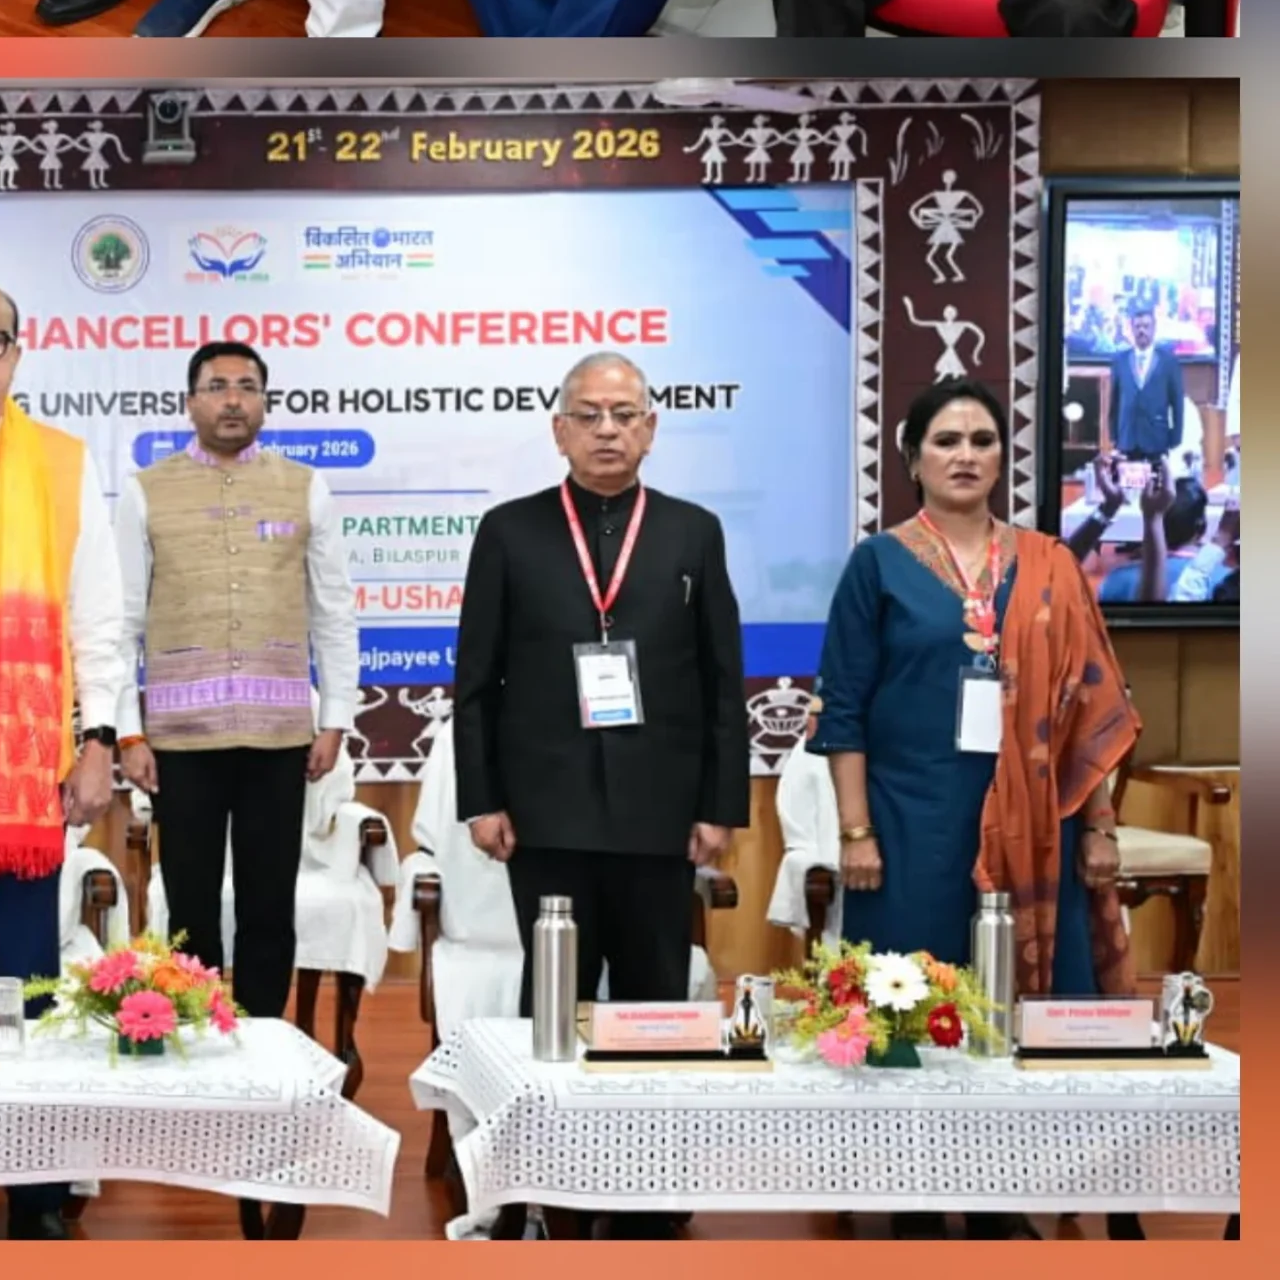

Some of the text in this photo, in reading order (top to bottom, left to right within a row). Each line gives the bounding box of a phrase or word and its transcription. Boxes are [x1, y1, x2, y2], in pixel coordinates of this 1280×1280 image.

[410, 131, 563, 167] February
[571, 128, 661, 159] 2026
[303, 226, 369, 248] विकसित
[335, 249, 403, 269] अभियान
[344, 308, 669, 347] CONFERENCE
[39, 391, 186, 418] UNIVERSI
[265, 388, 330, 415] FOR
[338, 386, 485, 414] HOLISTIC
[492, 383, 740, 413] DEVMENT
[321, 440, 359, 457] 2026
[342, 515, 480, 537] PARTMENT
[360, 646, 441, 671] ajpayee
